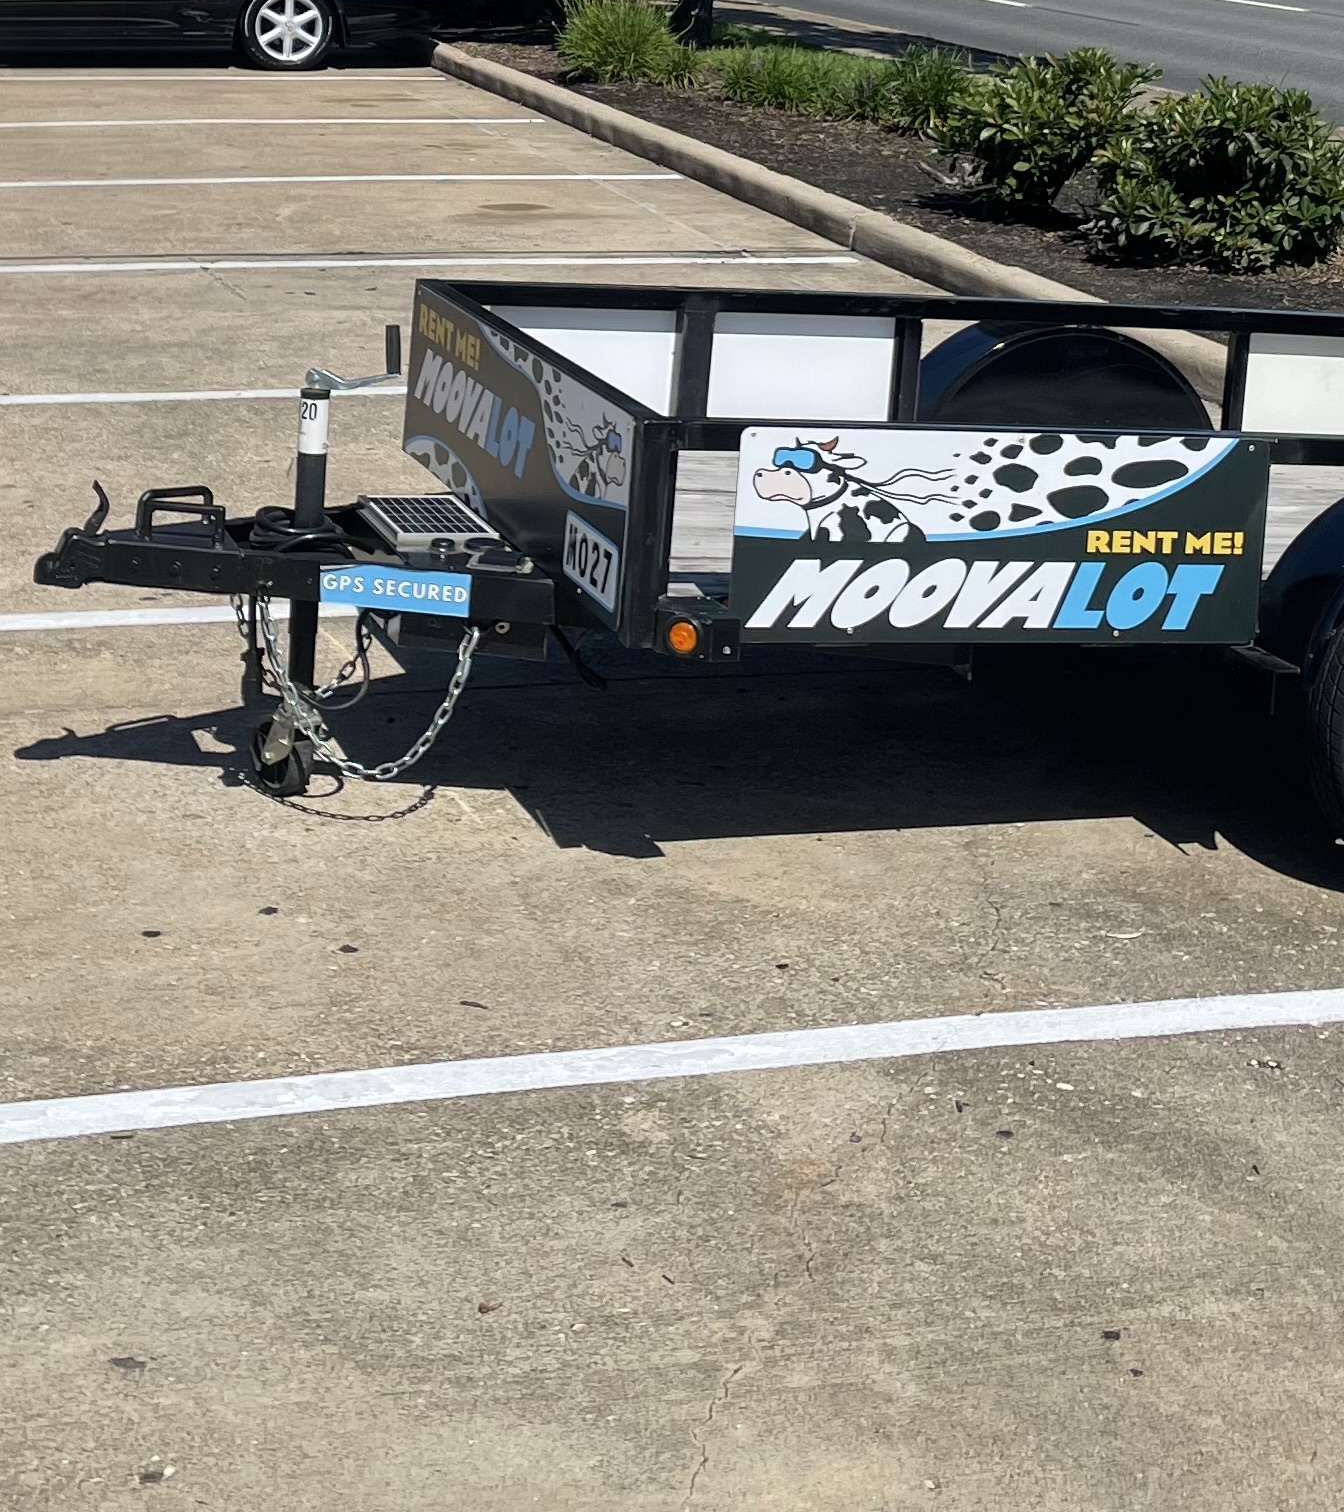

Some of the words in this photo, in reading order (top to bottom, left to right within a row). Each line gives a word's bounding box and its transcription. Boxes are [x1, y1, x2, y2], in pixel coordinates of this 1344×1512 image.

[418, 303, 455, 352] RENT
[455, 327, 482, 372] ME!
[301, 401, 317, 420] 20
[414, 347, 536, 479] MOOVALOT
[1086, 530, 1178, 555] RENT
[1184, 531, 1244, 555] ME!
[322, 573, 365, 593] GPS
[372, 578, 467, 603] SECURED
[744, 558, 1226, 631] MOOVALOT
